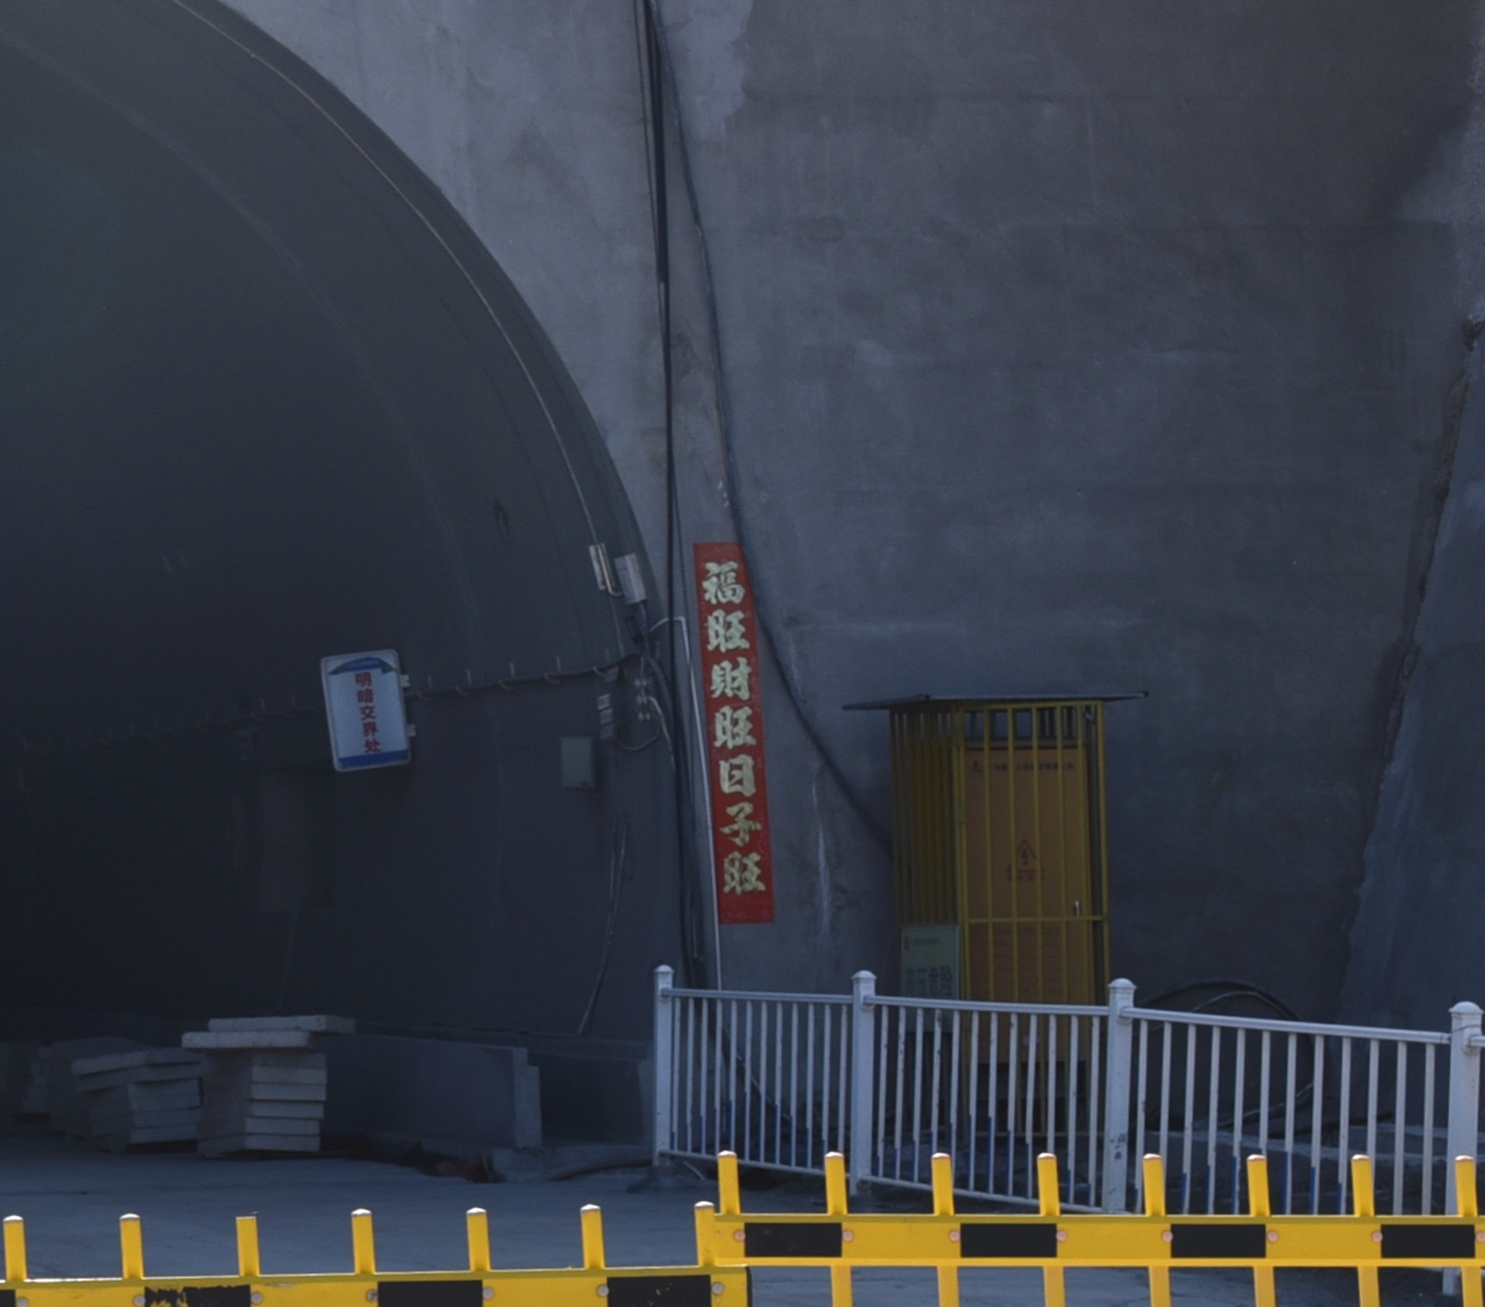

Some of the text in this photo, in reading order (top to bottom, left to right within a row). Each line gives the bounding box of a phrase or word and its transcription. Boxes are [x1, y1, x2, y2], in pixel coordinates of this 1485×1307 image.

[354, 672, 382, 753] 明暗交界处
